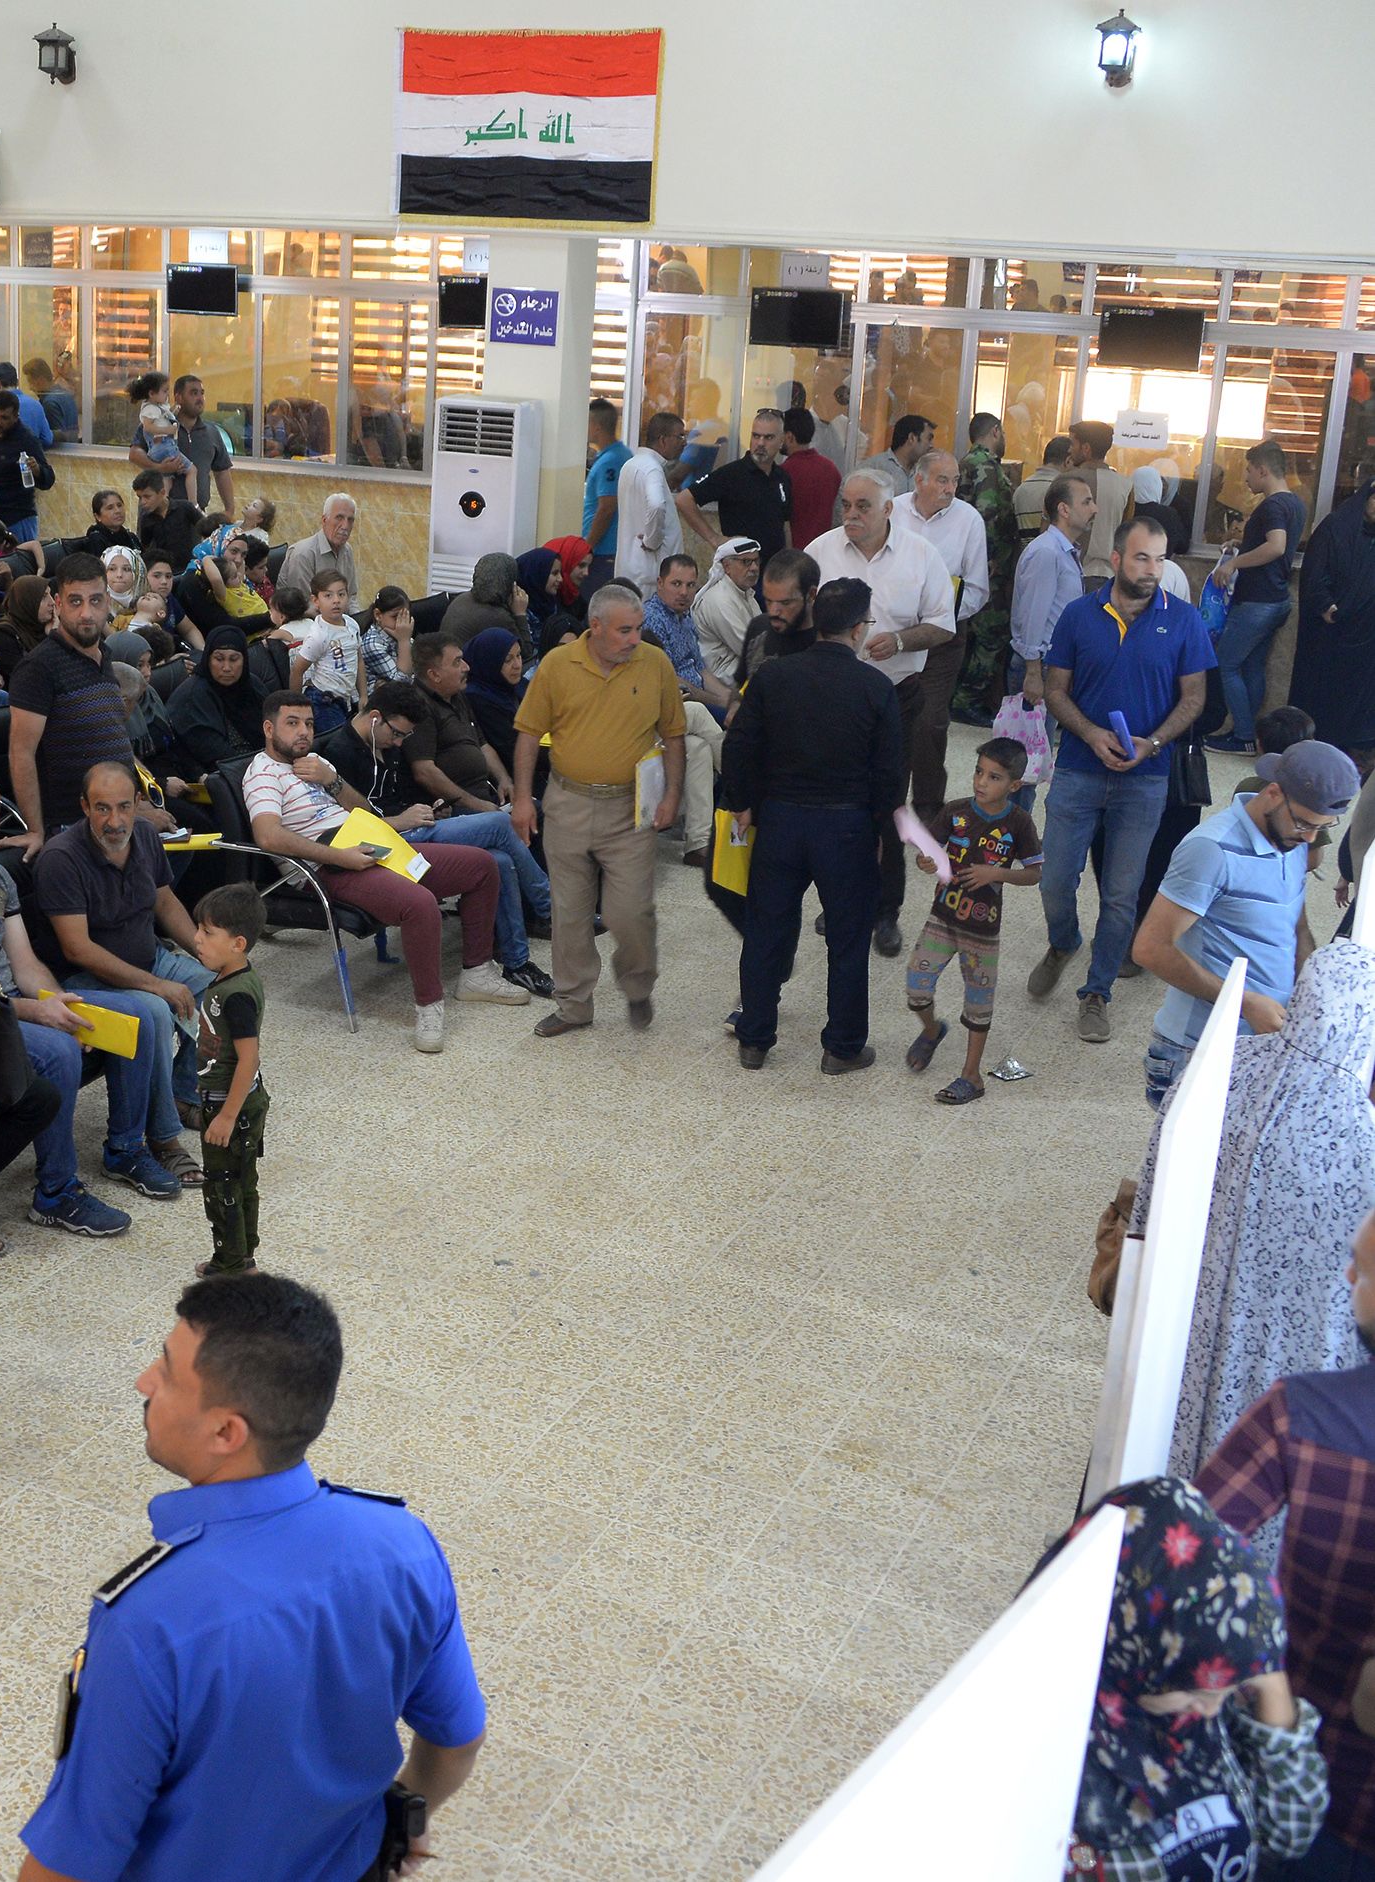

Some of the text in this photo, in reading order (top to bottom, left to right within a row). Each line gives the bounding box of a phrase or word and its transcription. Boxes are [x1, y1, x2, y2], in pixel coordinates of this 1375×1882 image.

[539, 109, 575, 144] الله
[520, 295, 553, 312] الرجاء
[496, 321, 554, 339] عدم التدخين
[978, 836, 1011, 856] PORT
[938, 886, 998, 922] idges
